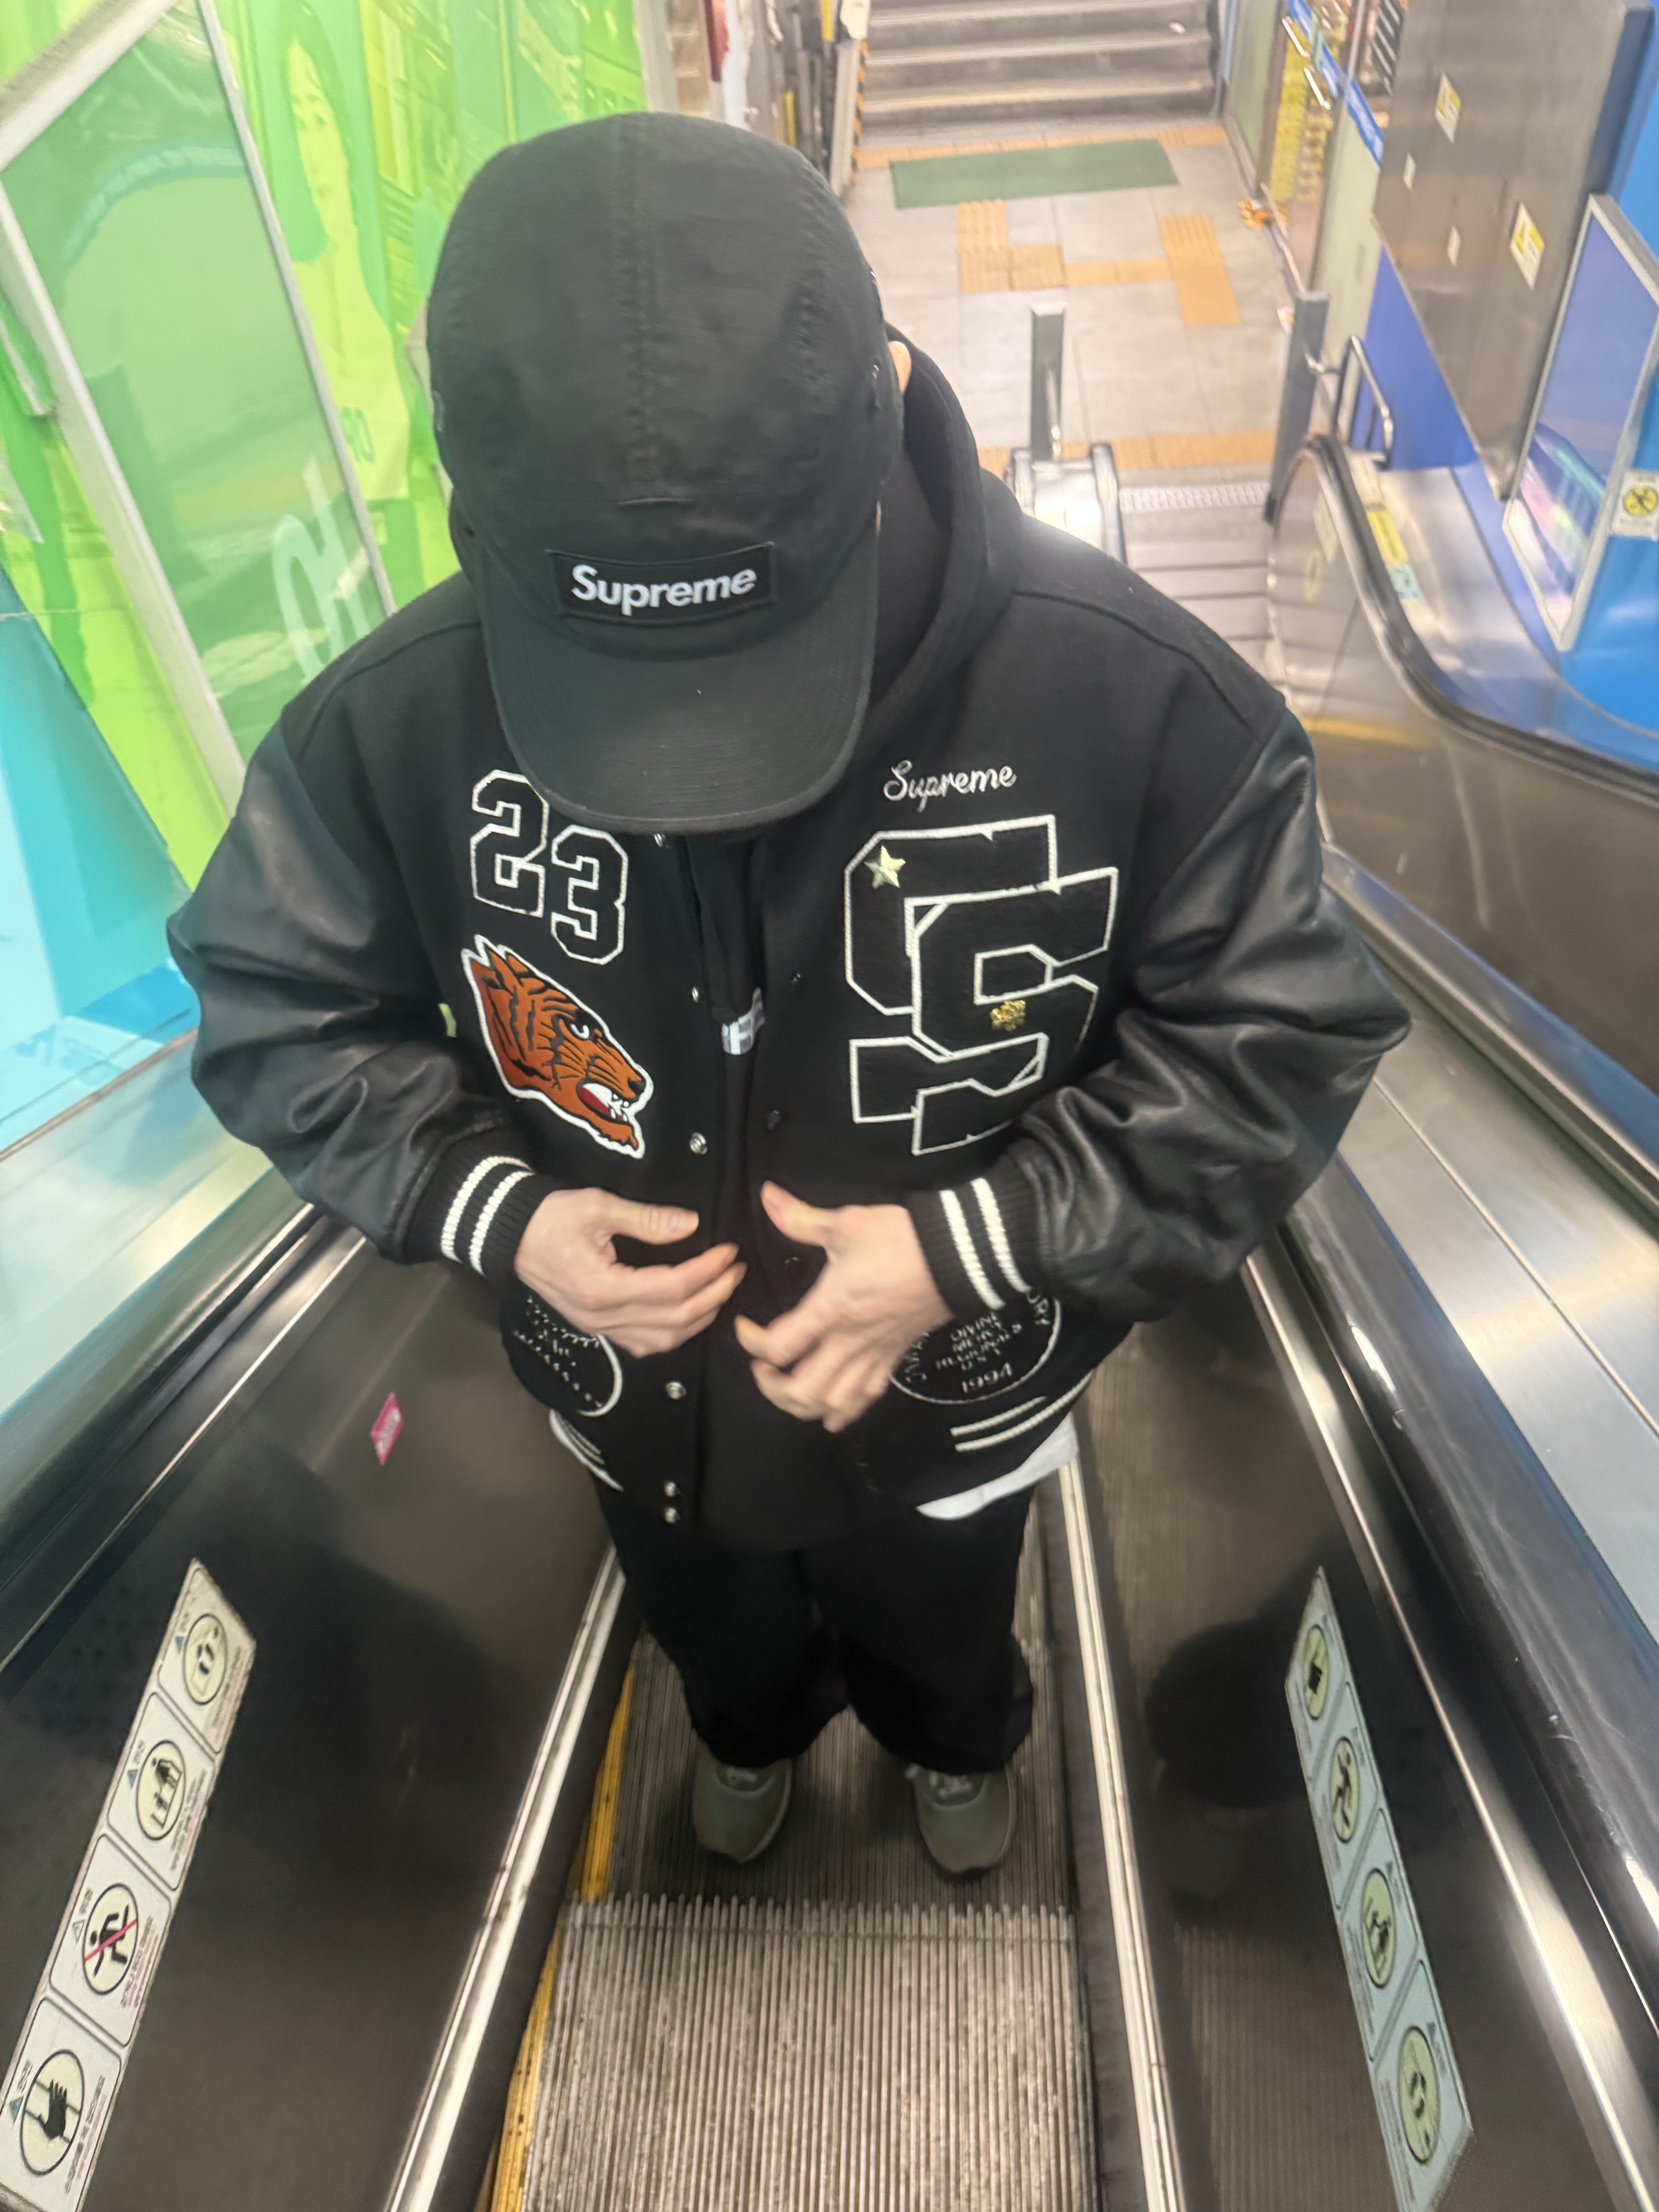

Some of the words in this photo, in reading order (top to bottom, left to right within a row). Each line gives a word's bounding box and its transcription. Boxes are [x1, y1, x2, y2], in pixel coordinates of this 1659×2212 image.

[571, 564, 757, 617] Supreme
[883, 760, 1017, 813] Supreme
[470, 769, 629, 965] 23
[962, 1362, 1012, 1394] 1994
